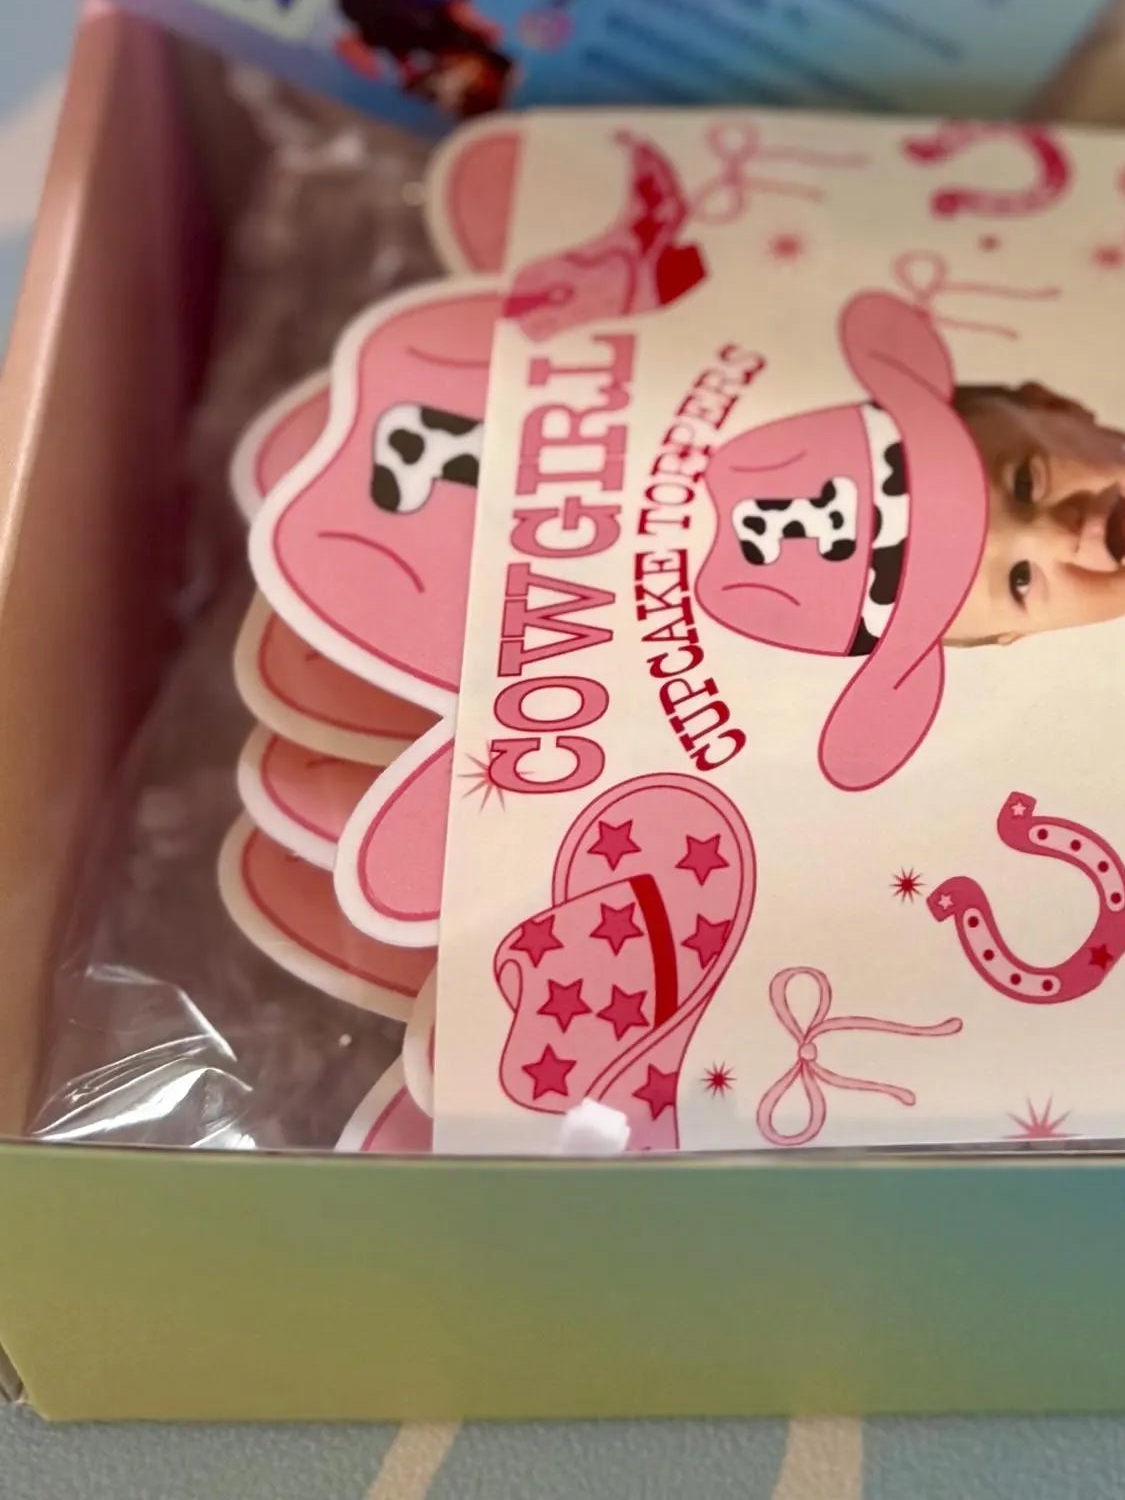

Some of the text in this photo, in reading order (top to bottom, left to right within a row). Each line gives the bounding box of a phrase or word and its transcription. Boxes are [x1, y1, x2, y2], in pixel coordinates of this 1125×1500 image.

[488, 333, 638, 794] COWGIRL
[634, 343, 767, 772] CUPCAKE TOPPERS
